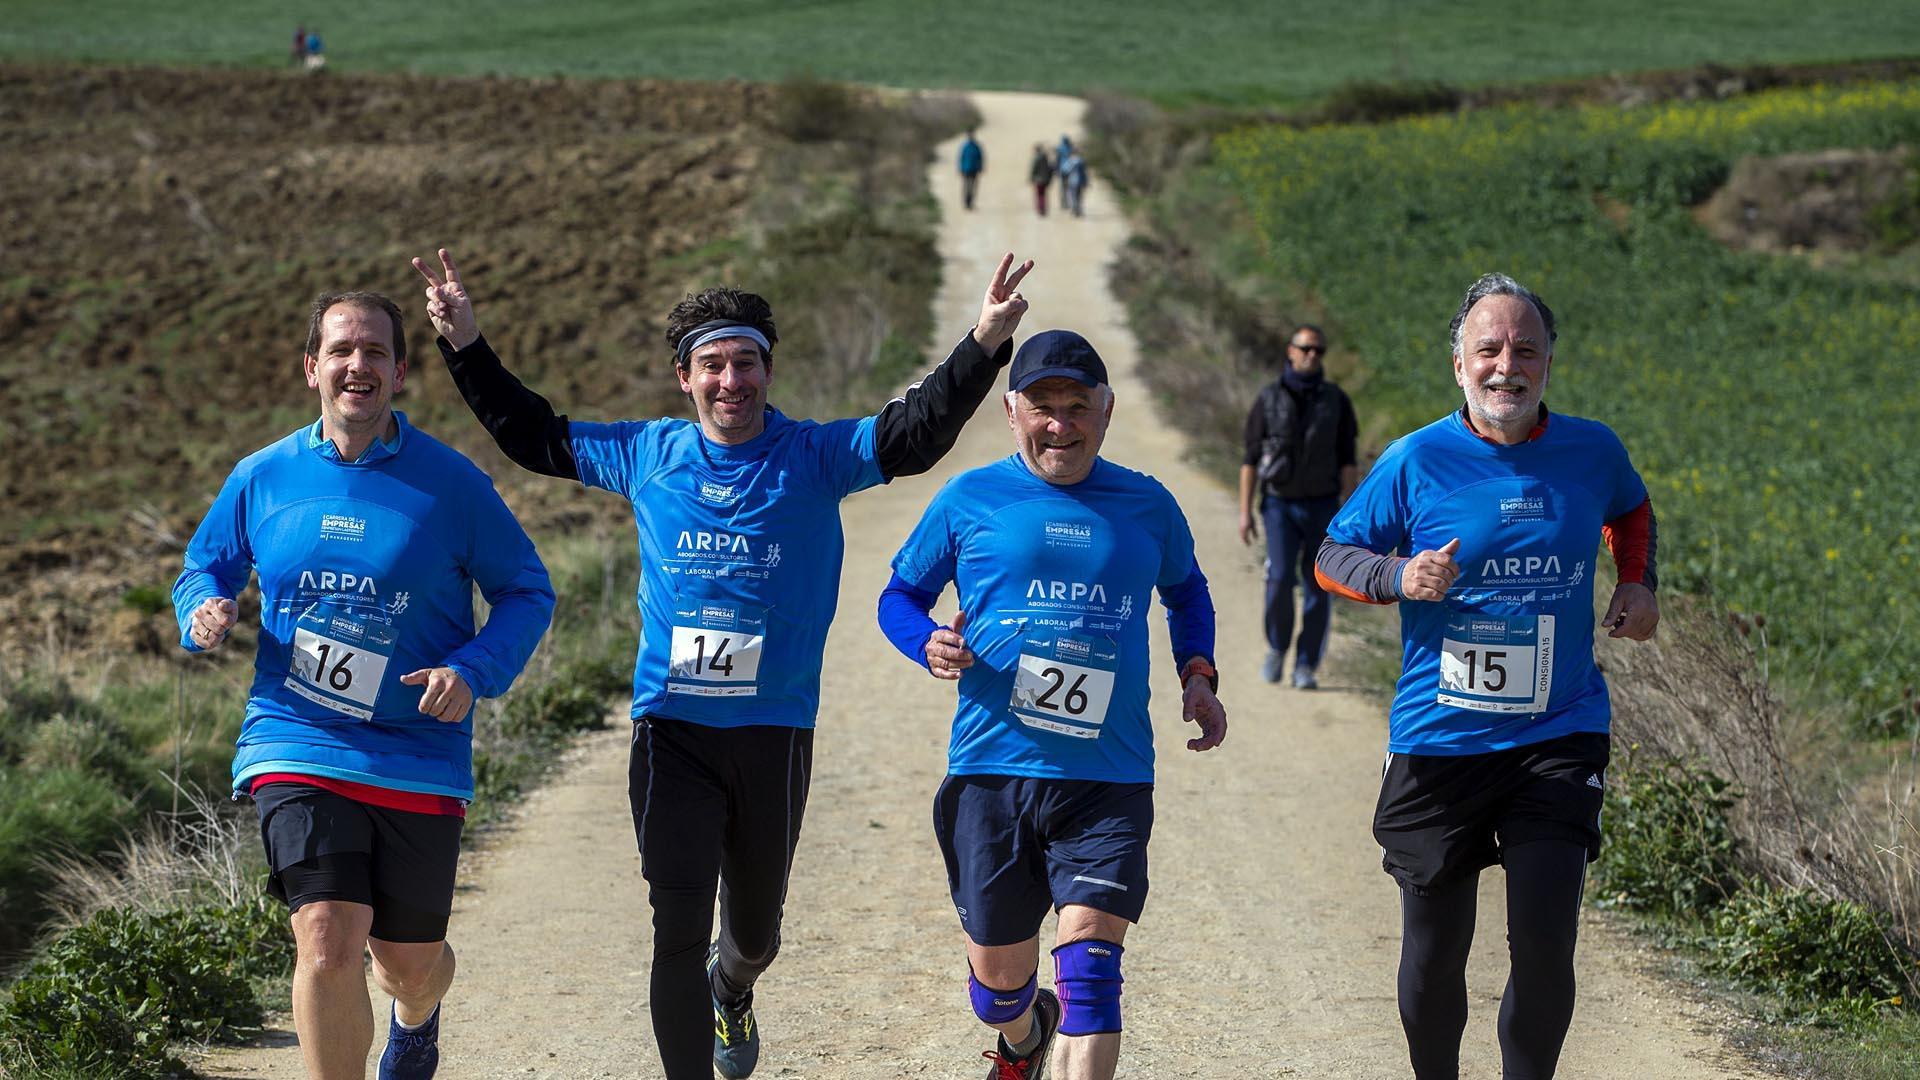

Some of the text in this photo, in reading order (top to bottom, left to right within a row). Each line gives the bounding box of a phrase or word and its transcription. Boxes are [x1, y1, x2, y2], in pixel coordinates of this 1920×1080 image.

[1501, 502, 1543, 510] EMPRESAS
[322, 520, 365, 530] EMPRESAS
[326, 514, 347, 522] CARRERA
[1045, 526, 1090, 537] EMPRESAS
[677, 531, 749, 553] ARPA
[1481, 555, 1561, 577] ARPA
[299, 571, 376, 595] ARPA
[1517, 576, 1558, 584] CONSULTORES
[333, 593, 374, 603] CONSULTORES
[1026, 579, 1106, 604] ARPA
[702, 610, 735, 618] EMPRESAS
[1063, 603, 1104, 612] CONSULTORES
[332, 620, 364, 634] EMPRESAS
[1057, 641, 1090, 653] EMPRESAS
[694, 635, 733, 676] 14
[315, 644, 355, 691] 16
[1464, 650, 1507, 692] 15
[1540, 637, 1550, 692] CONSIGNA 15
[1035, 667, 1088, 714] 26
